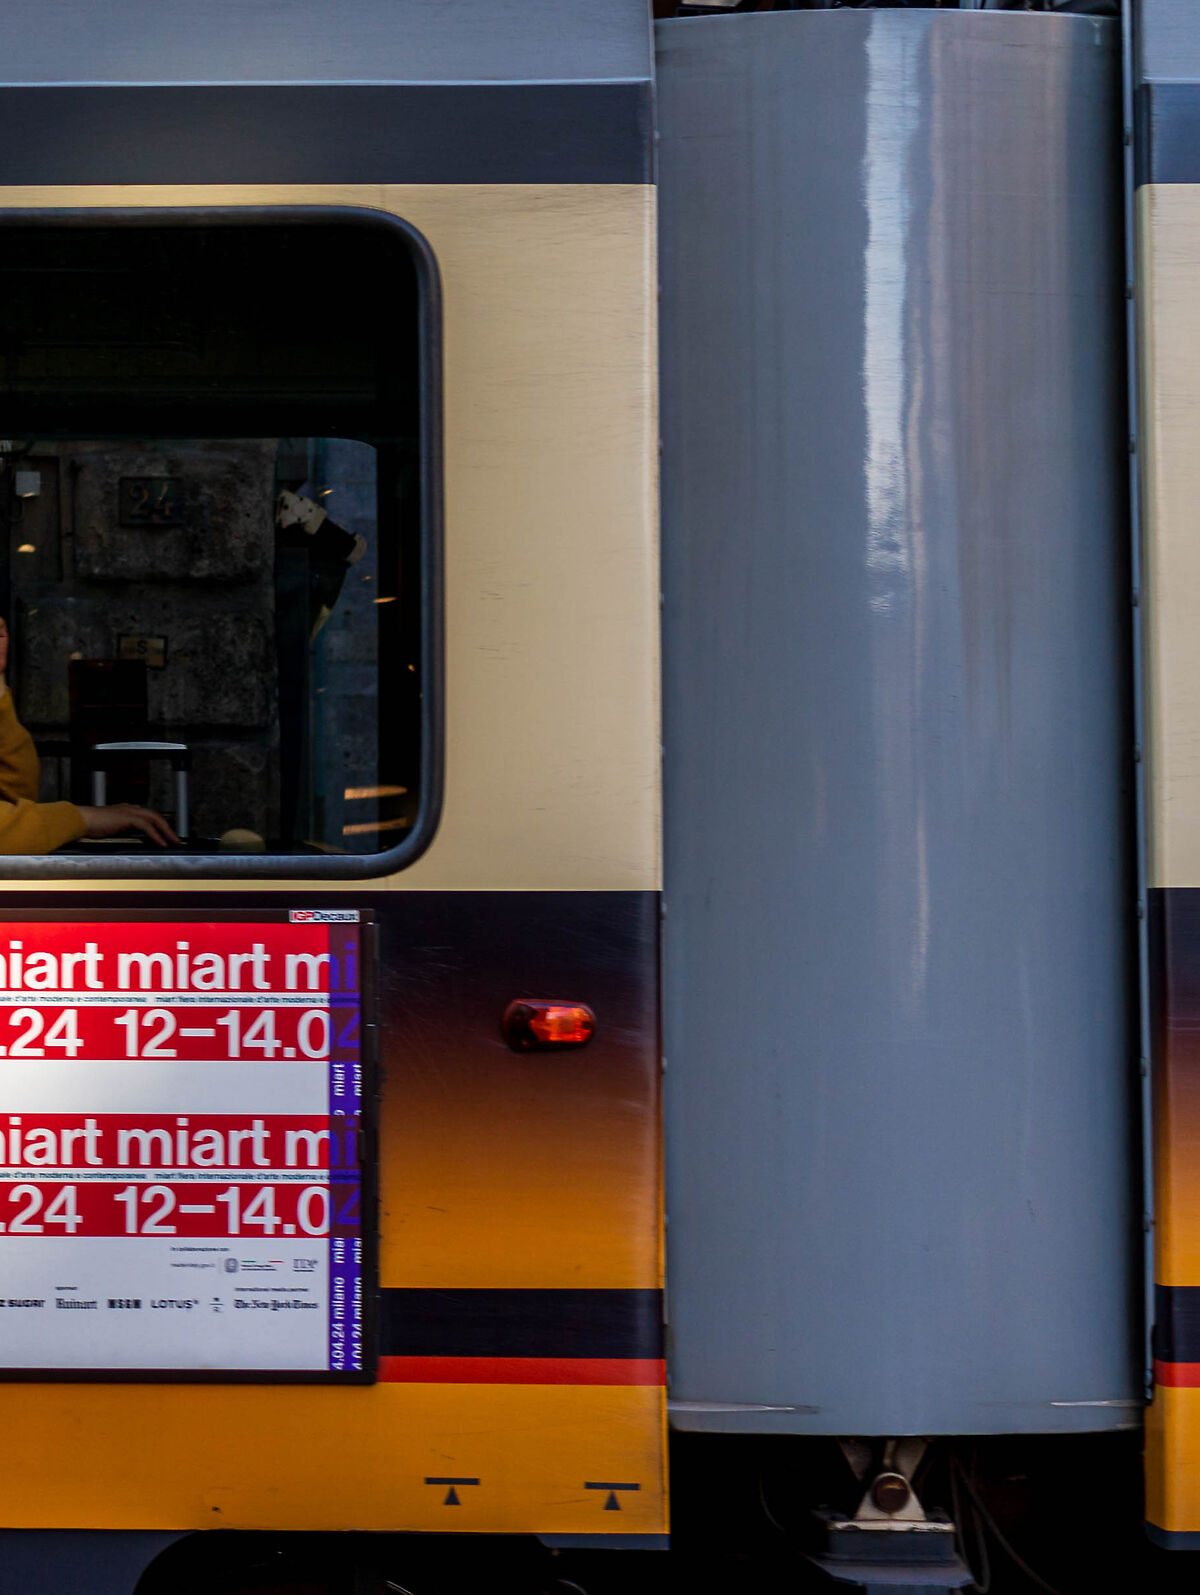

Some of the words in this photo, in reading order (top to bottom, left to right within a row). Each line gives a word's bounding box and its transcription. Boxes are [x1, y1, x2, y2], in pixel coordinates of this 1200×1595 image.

[128, 481, 174, 518] 24
[117, 942, 271, 991] miart
[117, 1118, 271, 1166] miart
